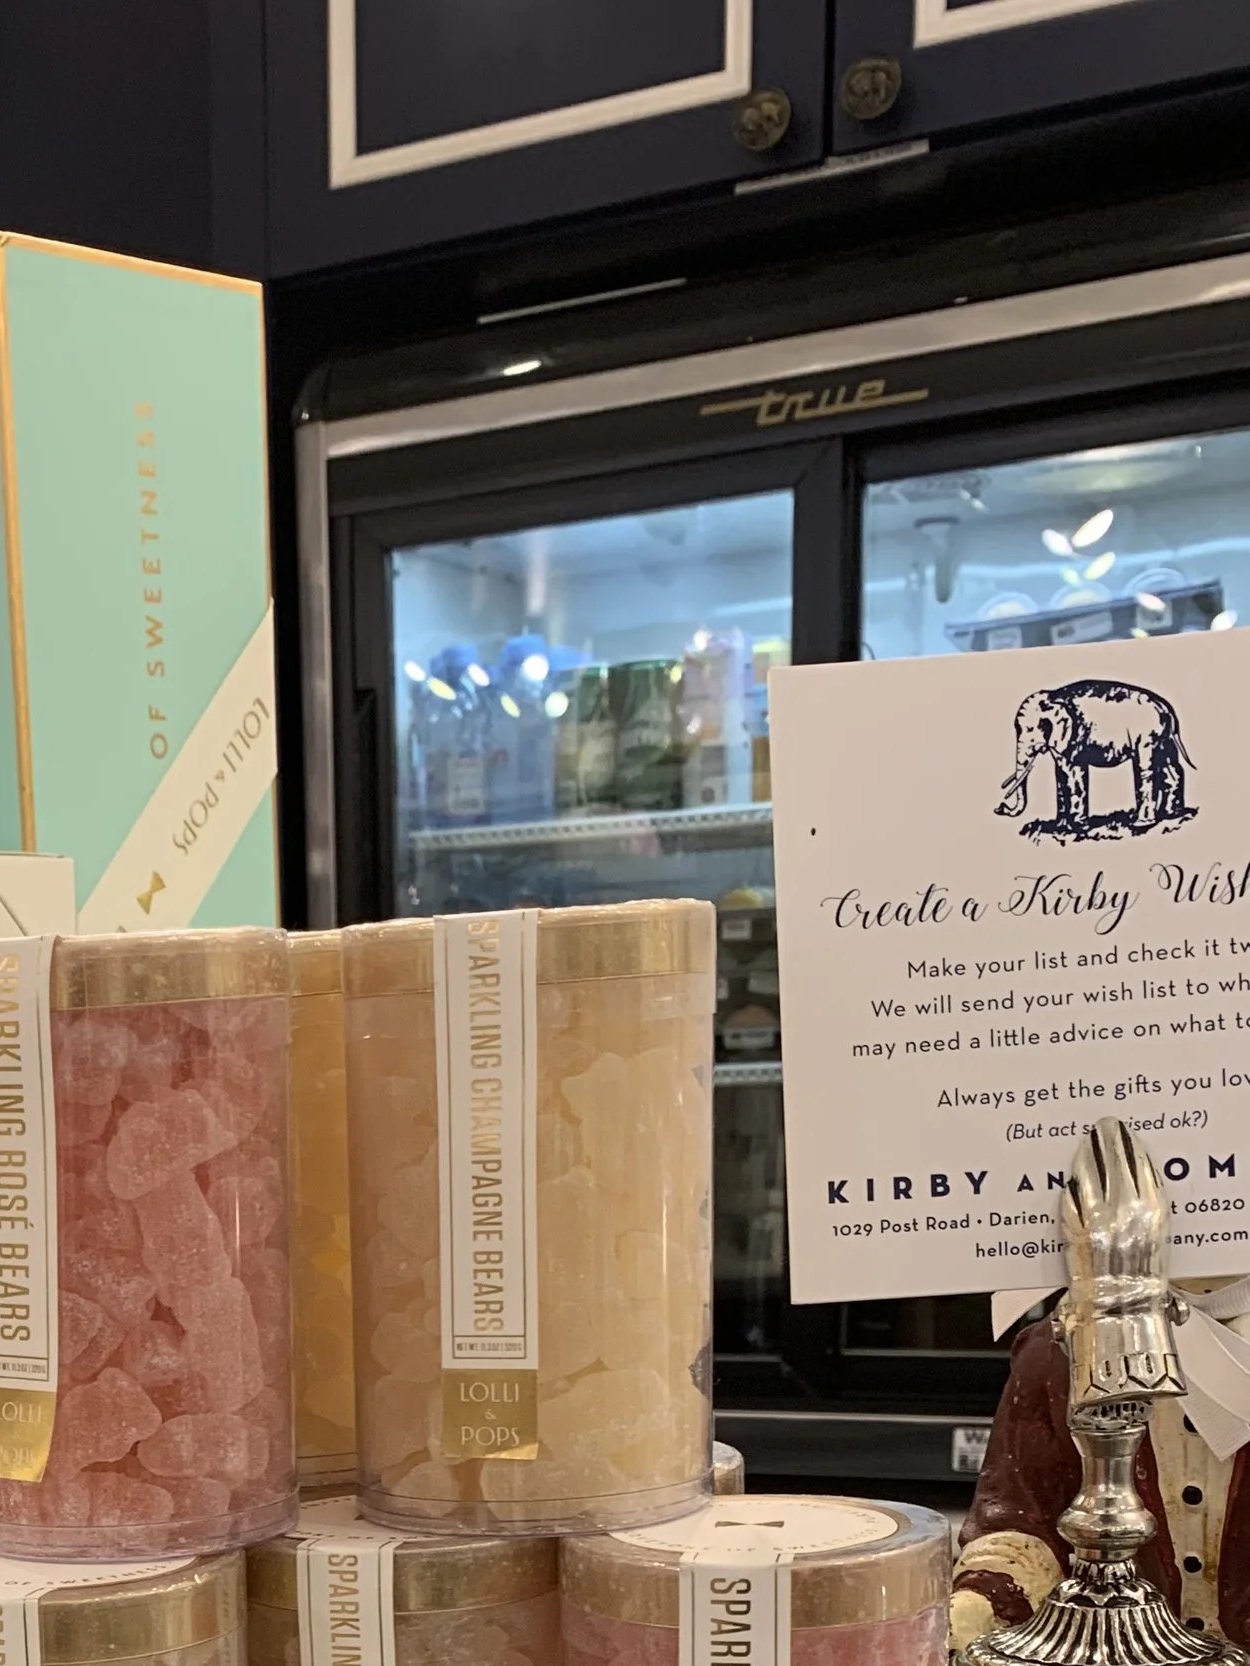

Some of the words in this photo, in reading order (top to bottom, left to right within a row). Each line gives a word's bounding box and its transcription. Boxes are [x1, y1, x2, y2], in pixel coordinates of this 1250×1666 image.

[735, 378, 905, 427] true
[133, 402, 167, 677] SWEETNESS
[148, 704, 170, 760] OF
[222, 697, 271, 776] LOLLI
[172, 781, 220, 857] POPS
[819, 882, 955, 930] Create
[961, 897, 989, 923] a
[997, 870, 1141, 936] Kirby
[907, 957, 967, 979] Make
[974, 958, 1026, 980] your
[1034, 950, 1068, 971] list
[1076, 944, 1119, 968] and
[1127, 938, 1196, 964] check
[1204, 938, 1221, 957] it
[466, 918, 503, 1070] SPARKLING
[870, 998, 907, 1018] We
[915, 994, 952, 1015] will
[960, 989, 1015, 1013] send
[1023, 992, 1075, 1014] your
[1082, 981, 1134, 1004] wish
[1142, 979, 1178, 1000] list
[1185, 978, 1210, 996] to
[852, 1042, 896, 1060] may
[905, 1030, 961, 1054] need
[969, 1037, 981, 1049] a
[989, 1025, 1041, 1048] little
[1049, 1022, 1125, 1045] advice
[1133, 1022, 1162, 1038] on
[1170, 1012, 1226, 1034] what
[937, 1087, 1016, 1109] Always
[1023, 1082, 1060, 1108] get
[1068, 1078, 1106, 1099] the
[1113, 1073, 1163, 1101] gifts
[1170, 1075, 1212, 1096] you
[1005, 1122, 1044, 1143] (But
[1048, 1120, 1078, 1138] act
[1169, 1109, 1209, 1130] ok?)
[469, 1072, 506, 1243] CHAMPAGNE
[827, 1170, 989, 1204] KIRBY
[1015, 1170, 1068, 1193] AN
[1163, 1153, 1236, 1182] OM
[832, 1223, 873, 1237] 1029
[880, 1217, 919, 1234] Post
[925, 1213, 971, 1231] Road
[989, 1210, 1056, 1228] Darien,
[1184, 1197, 1246, 1215] 06820
[471, 1250, 505, 1333] BEARS
[460, 1381, 519, 1403] LOLLI
[460, 1425, 520, 1448] POPS
